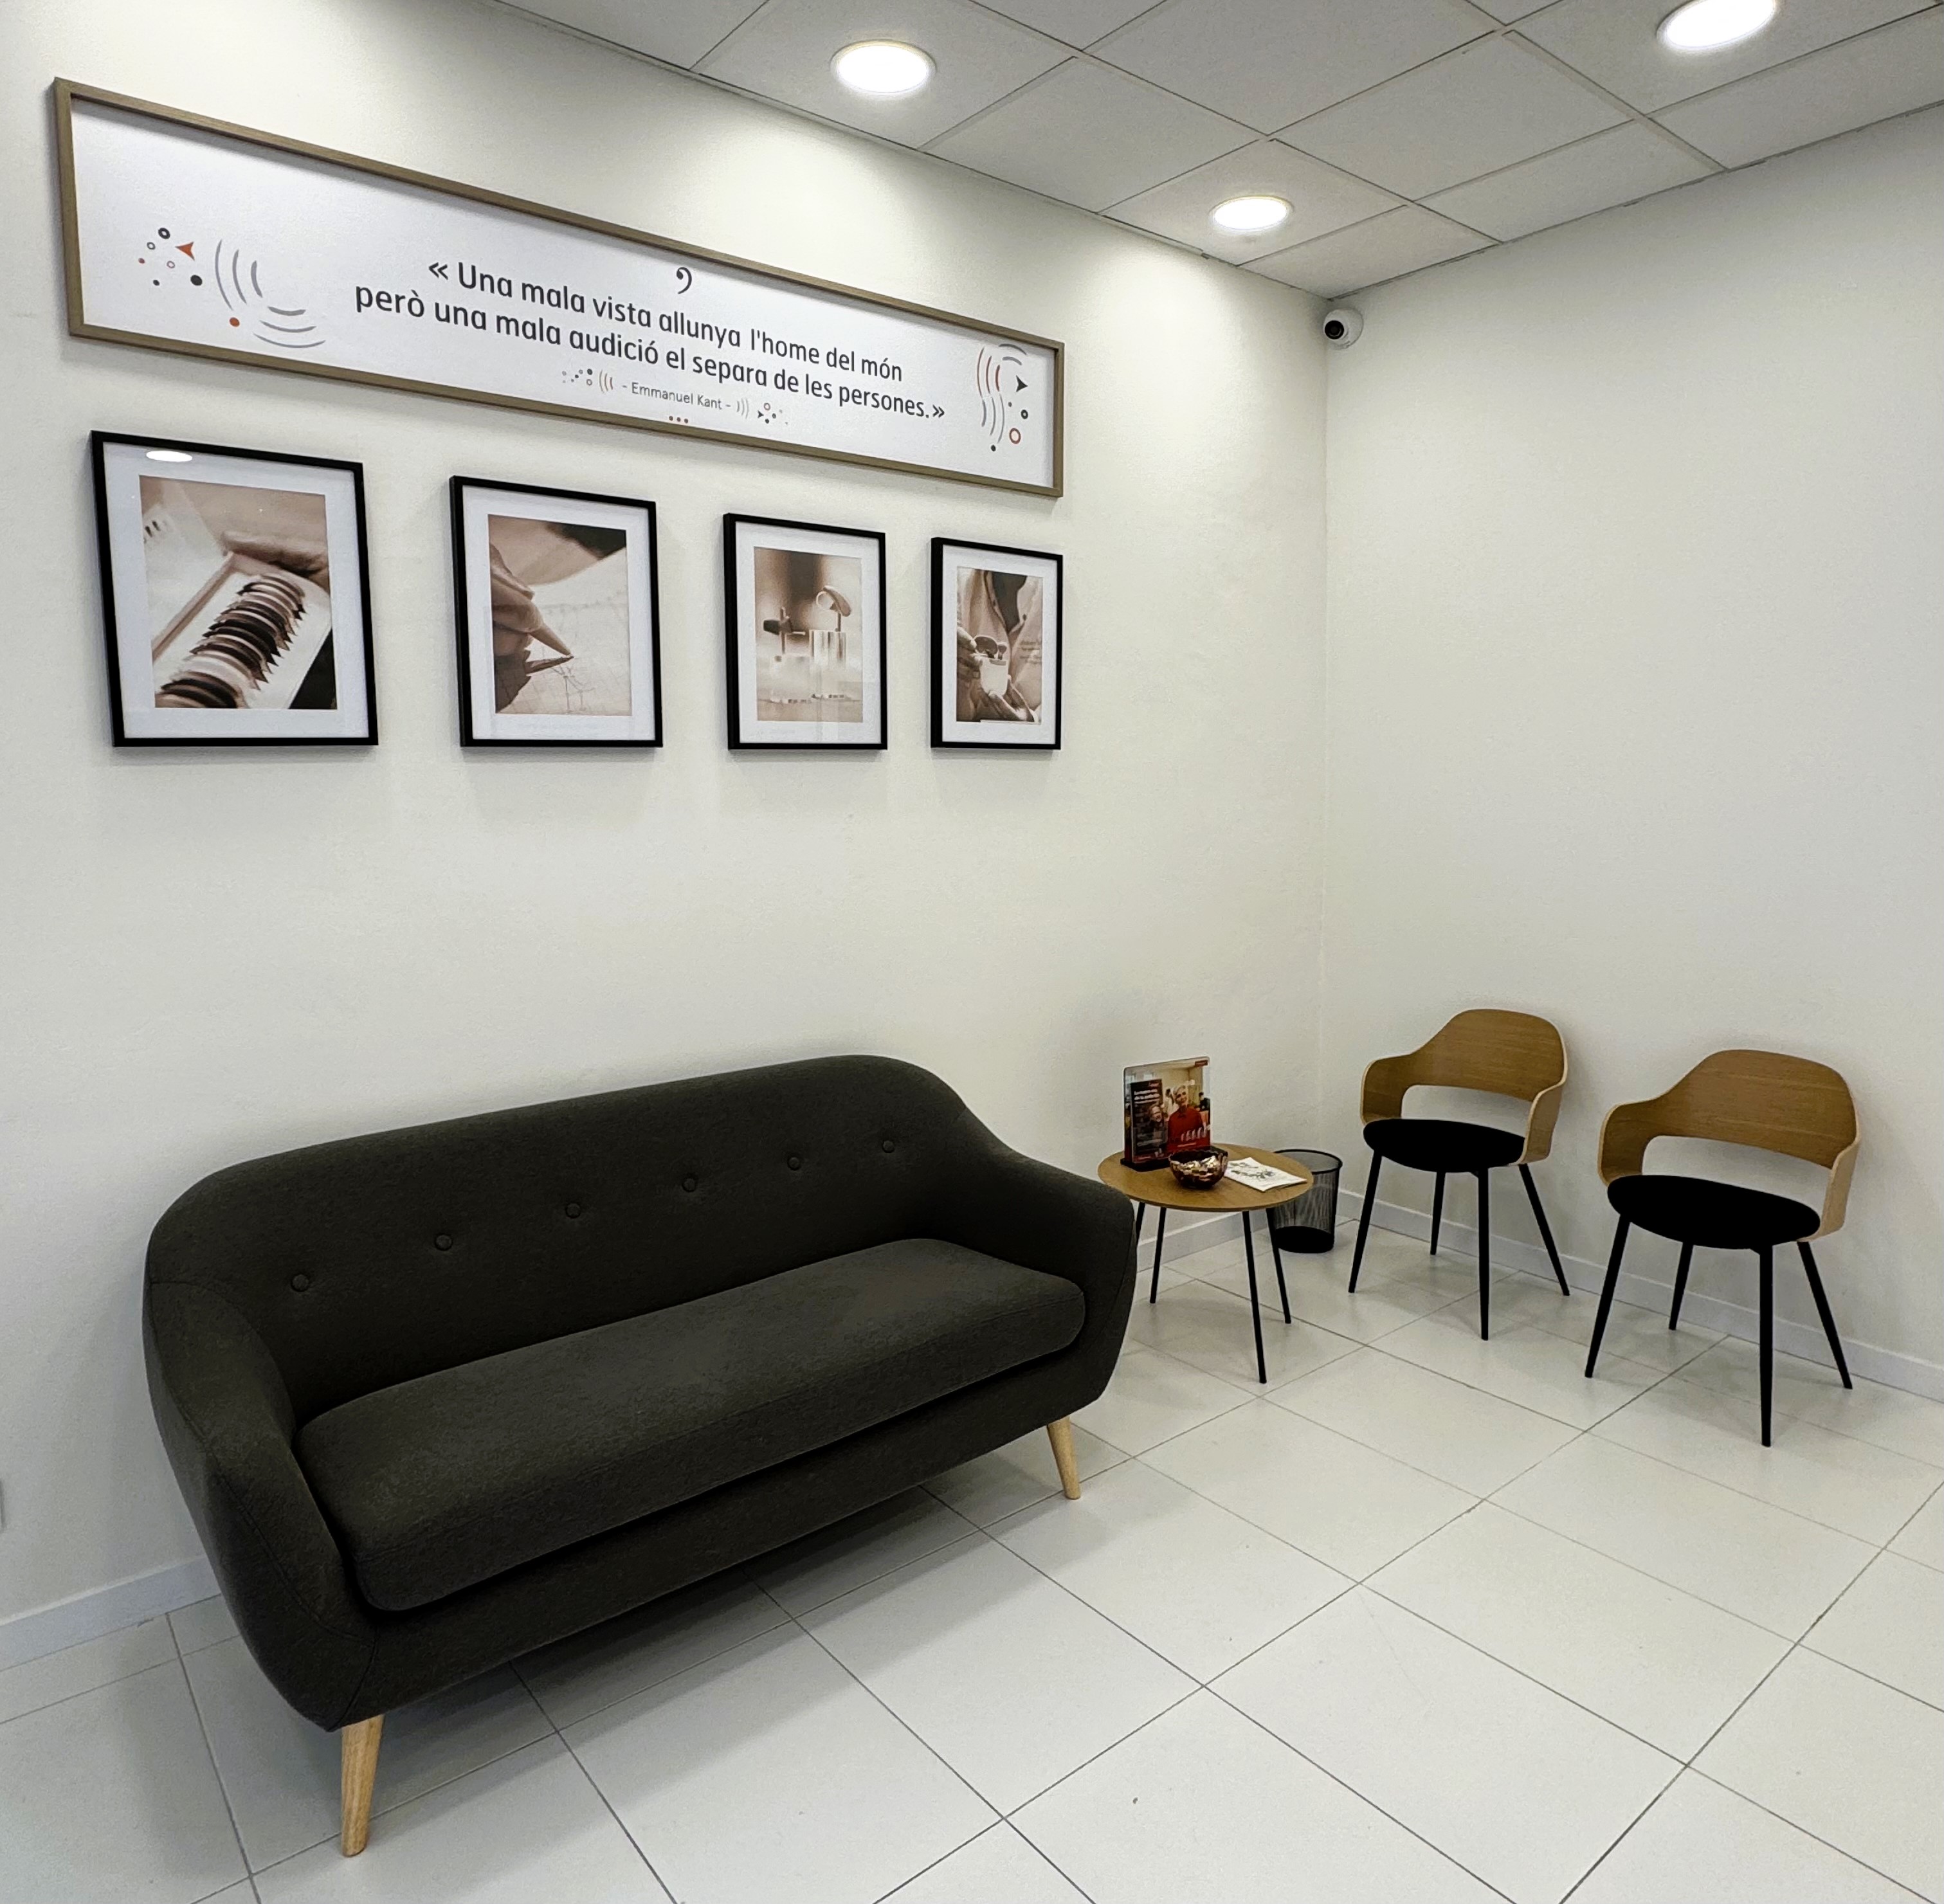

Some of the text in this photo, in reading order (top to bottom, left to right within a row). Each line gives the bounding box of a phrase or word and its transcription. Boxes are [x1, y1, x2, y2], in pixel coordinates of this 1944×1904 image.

[356, 286, 945, 419] però una mala audició el separa de les persones.»
[429, 262, 902, 382] « Una mala vista allunya l'home del món
[631, 381, 694, 404] Emmanuel
[697, 394, 723, 410] Kant
